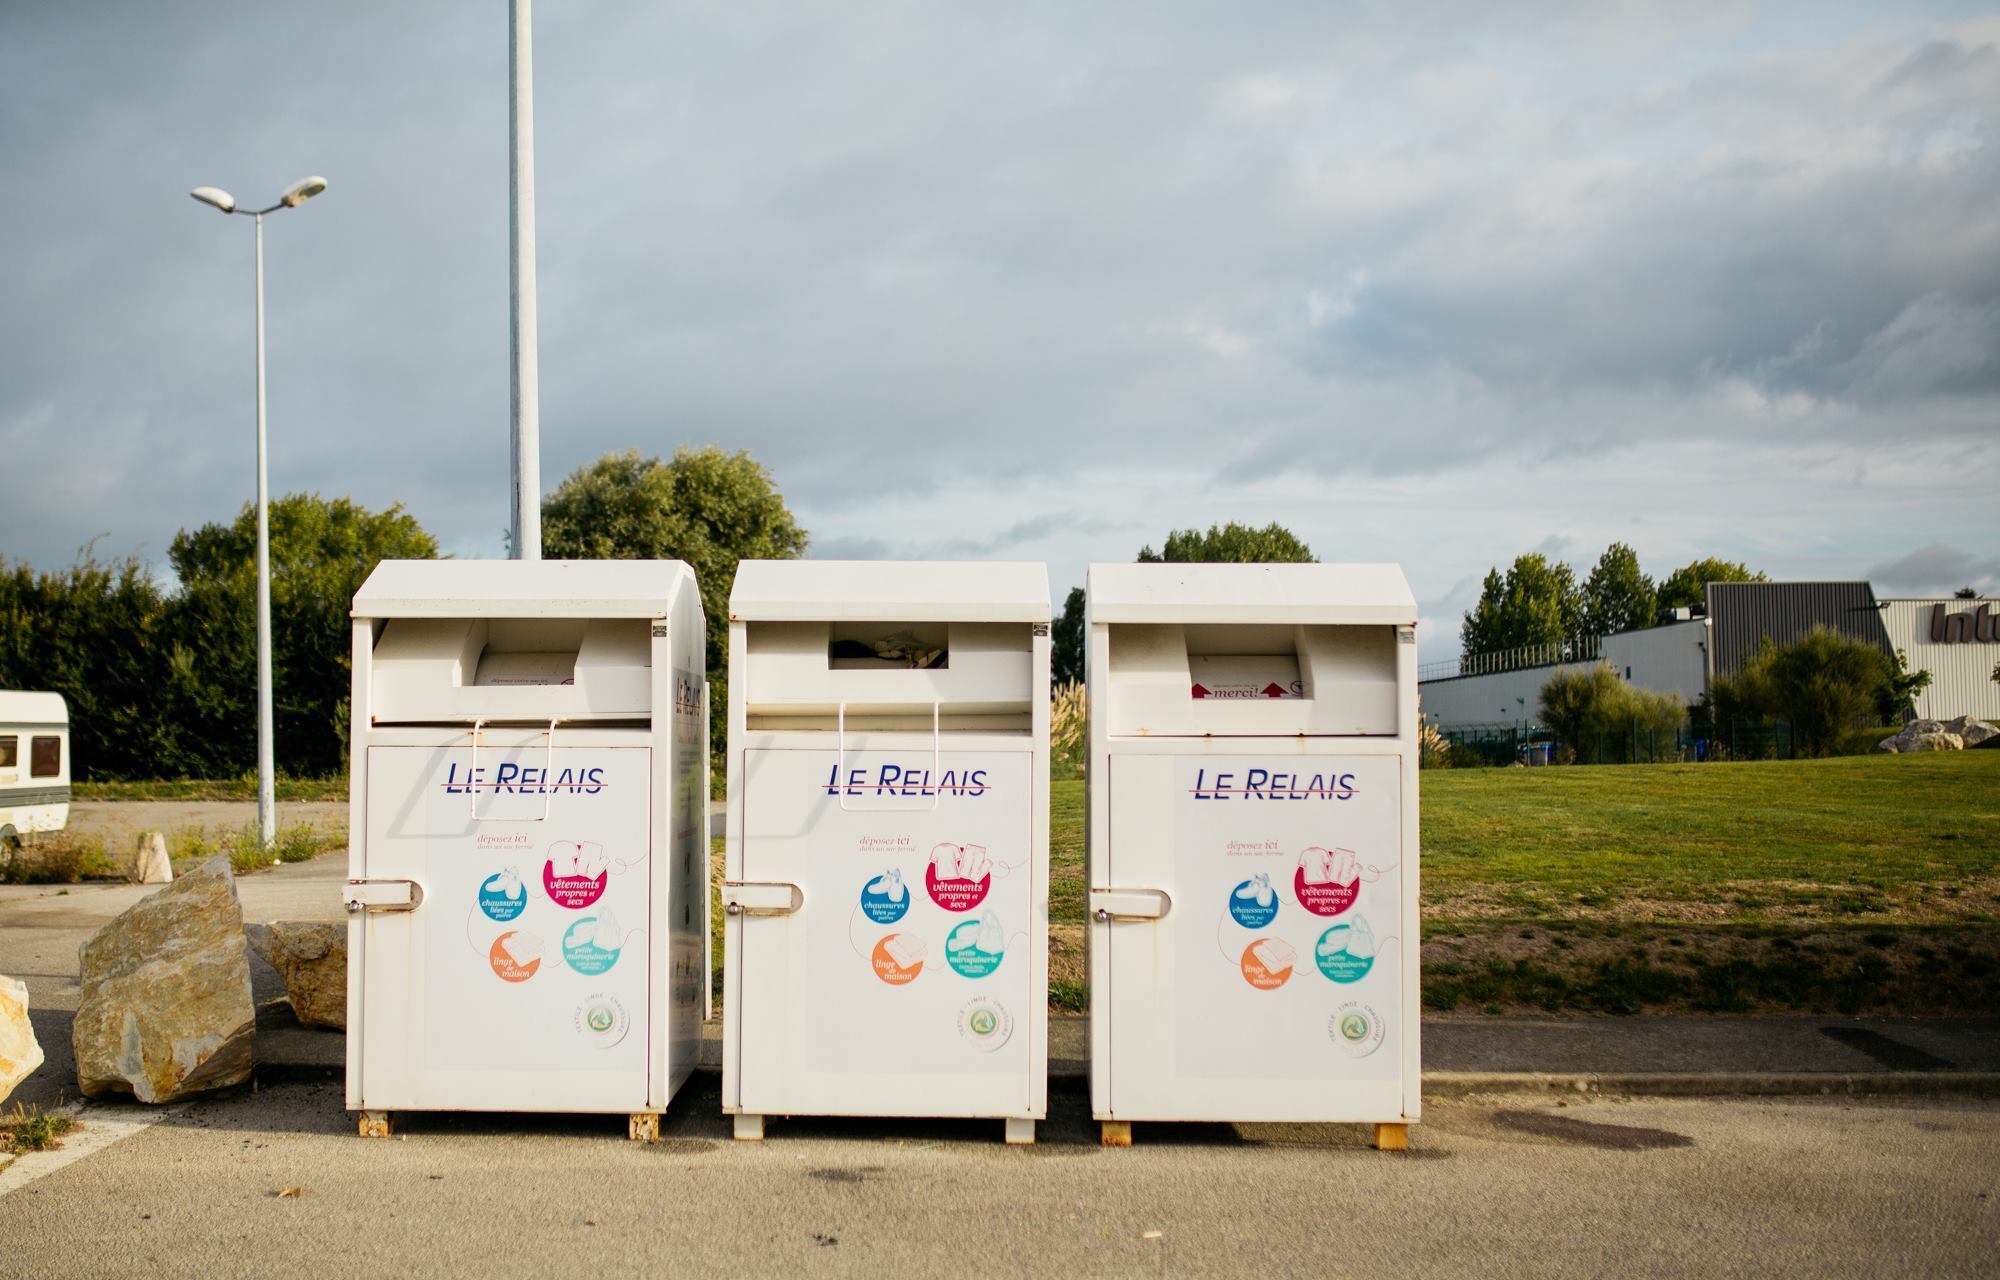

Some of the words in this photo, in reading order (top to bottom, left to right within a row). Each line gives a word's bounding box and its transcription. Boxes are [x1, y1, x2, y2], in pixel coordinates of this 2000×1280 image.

[1930, 603, 2000, 644] Int
[446, 763, 485, 794] LE
[495, 763, 604, 794] RELAIS
[828, 765, 867, 795] LE
[877, 765, 987, 796] RELAIS
[1195, 769, 1235, 800] LE
[1244, 769, 1356, 801] RELAIS
[514, 832, 528, 843] ici
[859, 836, 894, 847] déposez
[896, 834, 911, 845] ici
[1264, 839, 1279, 849] ici
[550, 879, 600, 889] vêtements
[933, 882, 983, 892] vêtements
[556, 889, 587, 899] propres
[938, 892, 970, 902] propres
[1301, 887, 1353, 897] vêtements
[481, 899, 523, 907] chaussures
[864, 901, 905, 909] chaussures
[1307, 897, 1340, 906] propres
[493, 957, 513, 967] linge
[875, 959, 896, 969] linge
[502, 970, 530, 978] maison
